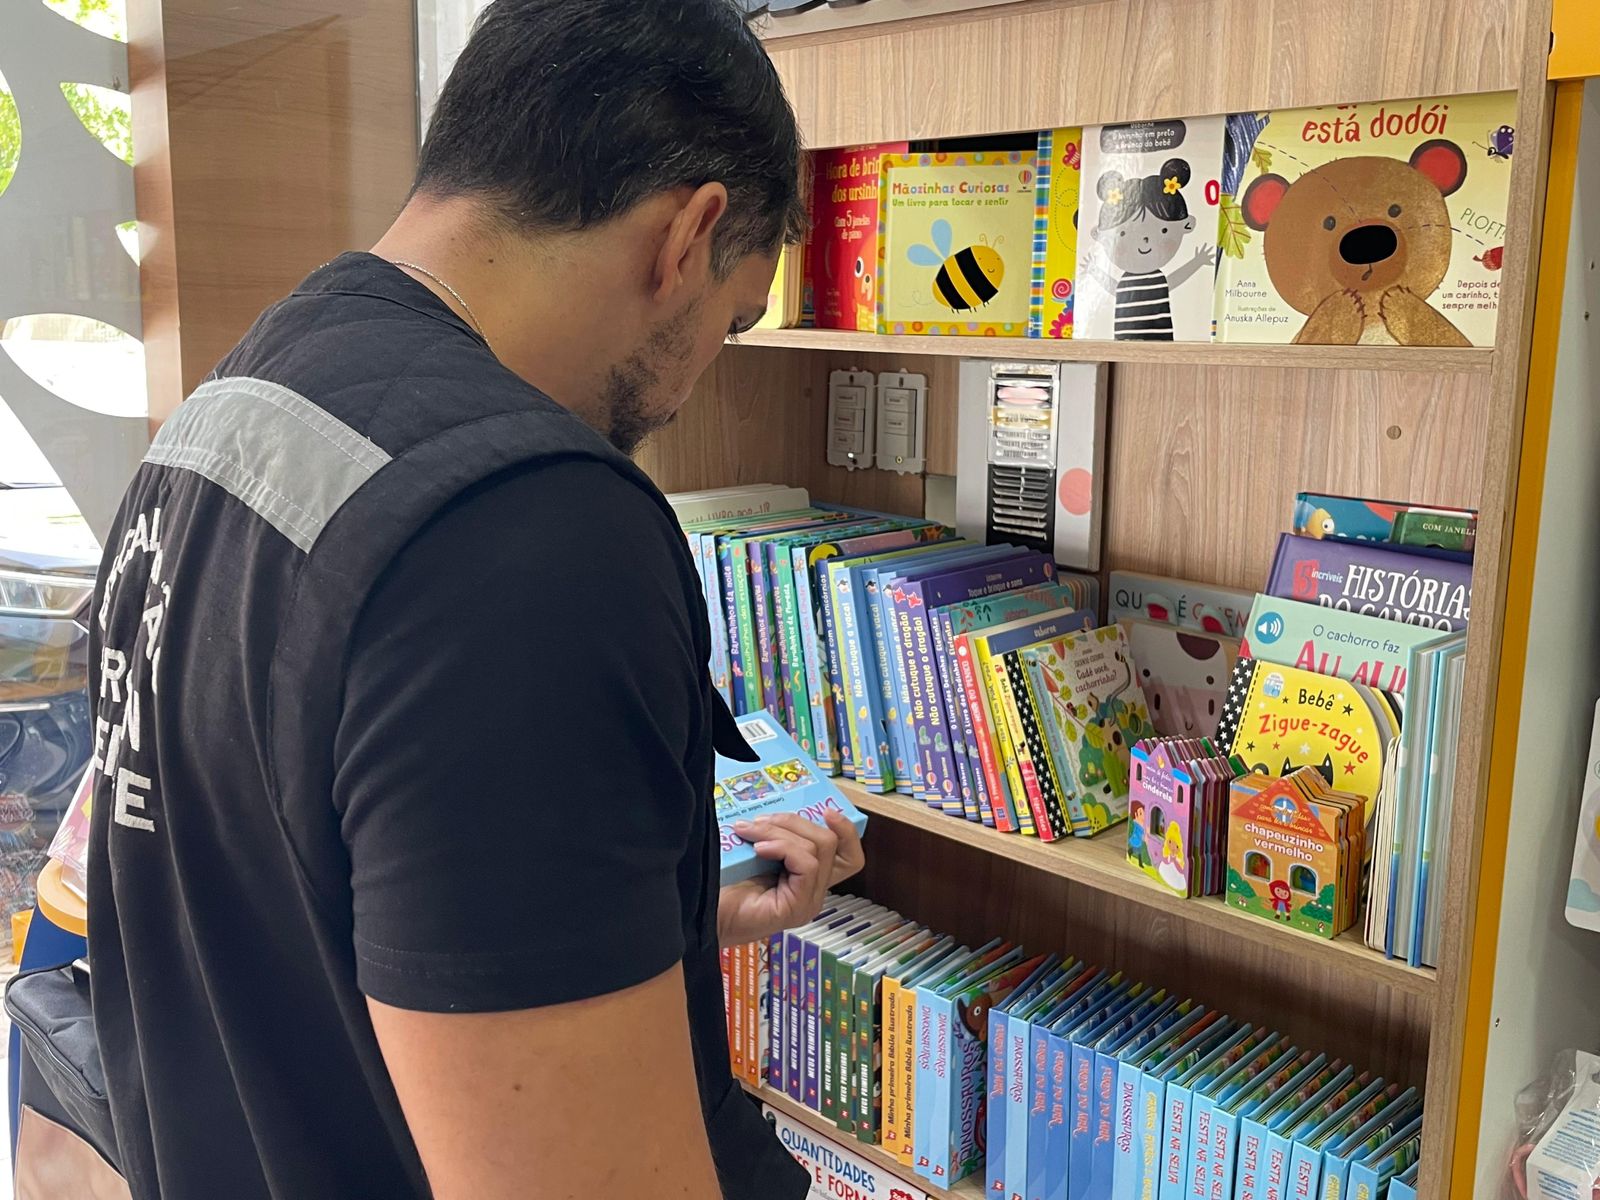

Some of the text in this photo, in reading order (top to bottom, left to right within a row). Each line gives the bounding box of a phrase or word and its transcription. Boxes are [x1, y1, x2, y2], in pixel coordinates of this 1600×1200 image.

[1156, 128, 1175, 138] preto
[1301, 104, 1449, 143] está dodói
[832, 182, 847, 203] dos
[892, 181, 1010, 195] Mãozinhas Curiosas
[892, 199, 904, 207] Um
[907, 198, 926, 207] livro
[928, 199, 949, 208] para
[952, 197, 974, 207] tocar
[984, 196, 1009, 206] sentir
[1460, 207, 1506, 240] PLOFT!
[1225, 289, 1267, 298] Milbourne
[1237, 280, 1256, 288] Anna
[1456, 288, 1492, 300] carinho,
[1457, 280, 1488, 291] Depois
[1224, 313, 1289, 325] Anuska Allepuz
[1442, 302, 1475, 311] sempre
[1422, 522, 1443, 532] COM
[1311, 567, 1344, 584] incríveis
[726, 591, 734, 602] da
[819, 574, 831, 617] unicórnios
[826, 619, 832, 628] os
[842, 602, 853, 628] vaca!
[870, 603, 881, 629] vaca!
[899, 611, 913, 649] dragão!
[932, 616, 942, 652] Elefantes
[1313, 624, 1400, 653] O cachorro faz
[831, 649, 839, 675] Dance
[848, 639, 860, 677] cutuque
[878, 640, 889, 678] cutuque
[913, 616, 941, 726] Não cutuque o dragão!
[940, 655, 950, 688] Dedinhos
[853, 679, 863, 698] Não
[882, 680, 892, 699] Não
[908, 659, 921, 698] cutuque
[953, 659, 964, 693] Dedinhos
[915, 699, 925, 719] Não
[948, 704, 956, 723] Livro
[1298, 688, 1335, 711] Bebê
[963, 709, 971, 728] Livro
[1259, 713, 1369, 764] Zigue-zague
[1142, 781, 1172, 803] cinderela
[1244, 822, 1324, 852] chapeuzinho
[1254, 838, 1313, 862] vermelho
[772, 997, 780, 1037] PRIMEIROS
[905, 1005, 913, 1046] ilustrada
[772, 1038, 780, 1060] MEUS
[790, 1006, 798, 1070] MEUS PRIMEIROS
[807, 1014, 816, 1079] MEUS PRIMEIROS
[918, 1005, 931, 1070] DINOSSAUROS
[934, 1013, 947, 1078] DINOSSAUROS
[824, 1040, 832, 1073] PRIMEIROS
[1010, 1036, 1024, 1104] DINOSSAUROS
[824, 1074, 832, 1092] MEUS
[840, 1052, 848, 1103] MEUS PRIMEIROS
[860, 1063, 868, 1115] MEUS PRIMEIROS
[888, 1061, 896, 1097] primeira
[904, 1075, 914, 1111] primeira
[960, 1041, 977, 1165] DINOSSAUROS
[1117, 1082, 1133, 1153] DINOSSAUROS
[1168, 1099, 1184, 1184] FESTA NA SELVA
[1193, 1110, 1211, 1196] FESTA NA SELVA
[1212, 1124, 1228, 1178] FESTA NA
[1243, 1135, 1259, 1171] FESTA
[781, 1127, 875, 1193] QUANTIDADES
[815, 1166, 822, 1184] E
[1268, 1148, 1284, 1185] FESTA
[1243, 1173, 1255, 1189] NA
[1295, 1158, 1312, 1198] FESTA
